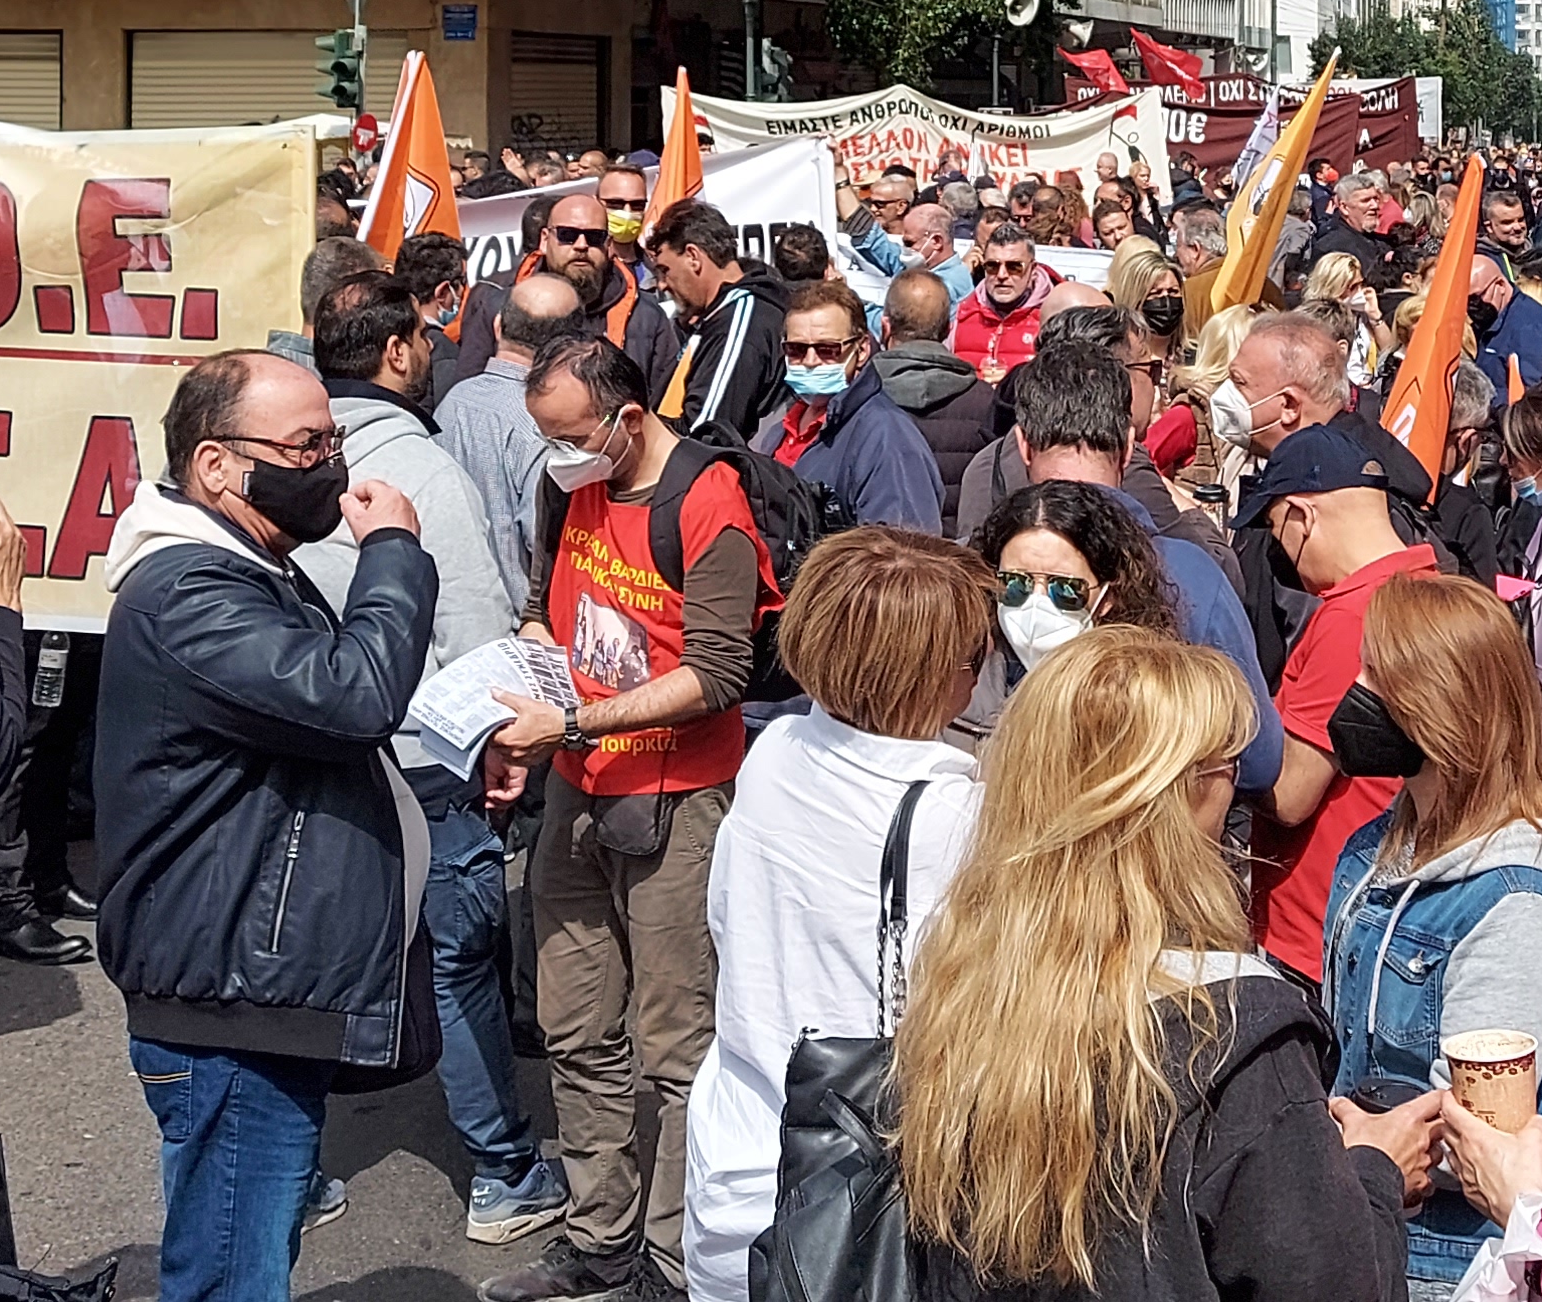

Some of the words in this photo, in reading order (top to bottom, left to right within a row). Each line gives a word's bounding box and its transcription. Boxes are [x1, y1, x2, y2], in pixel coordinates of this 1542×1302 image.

[766, 114, 843, 136] ΕΙΜΑΣΤΕ
[939, 113, 967, 132] ΟΧΙ
[974, 122, 1051, 140] ΑΡΙΘΜΟΙ
